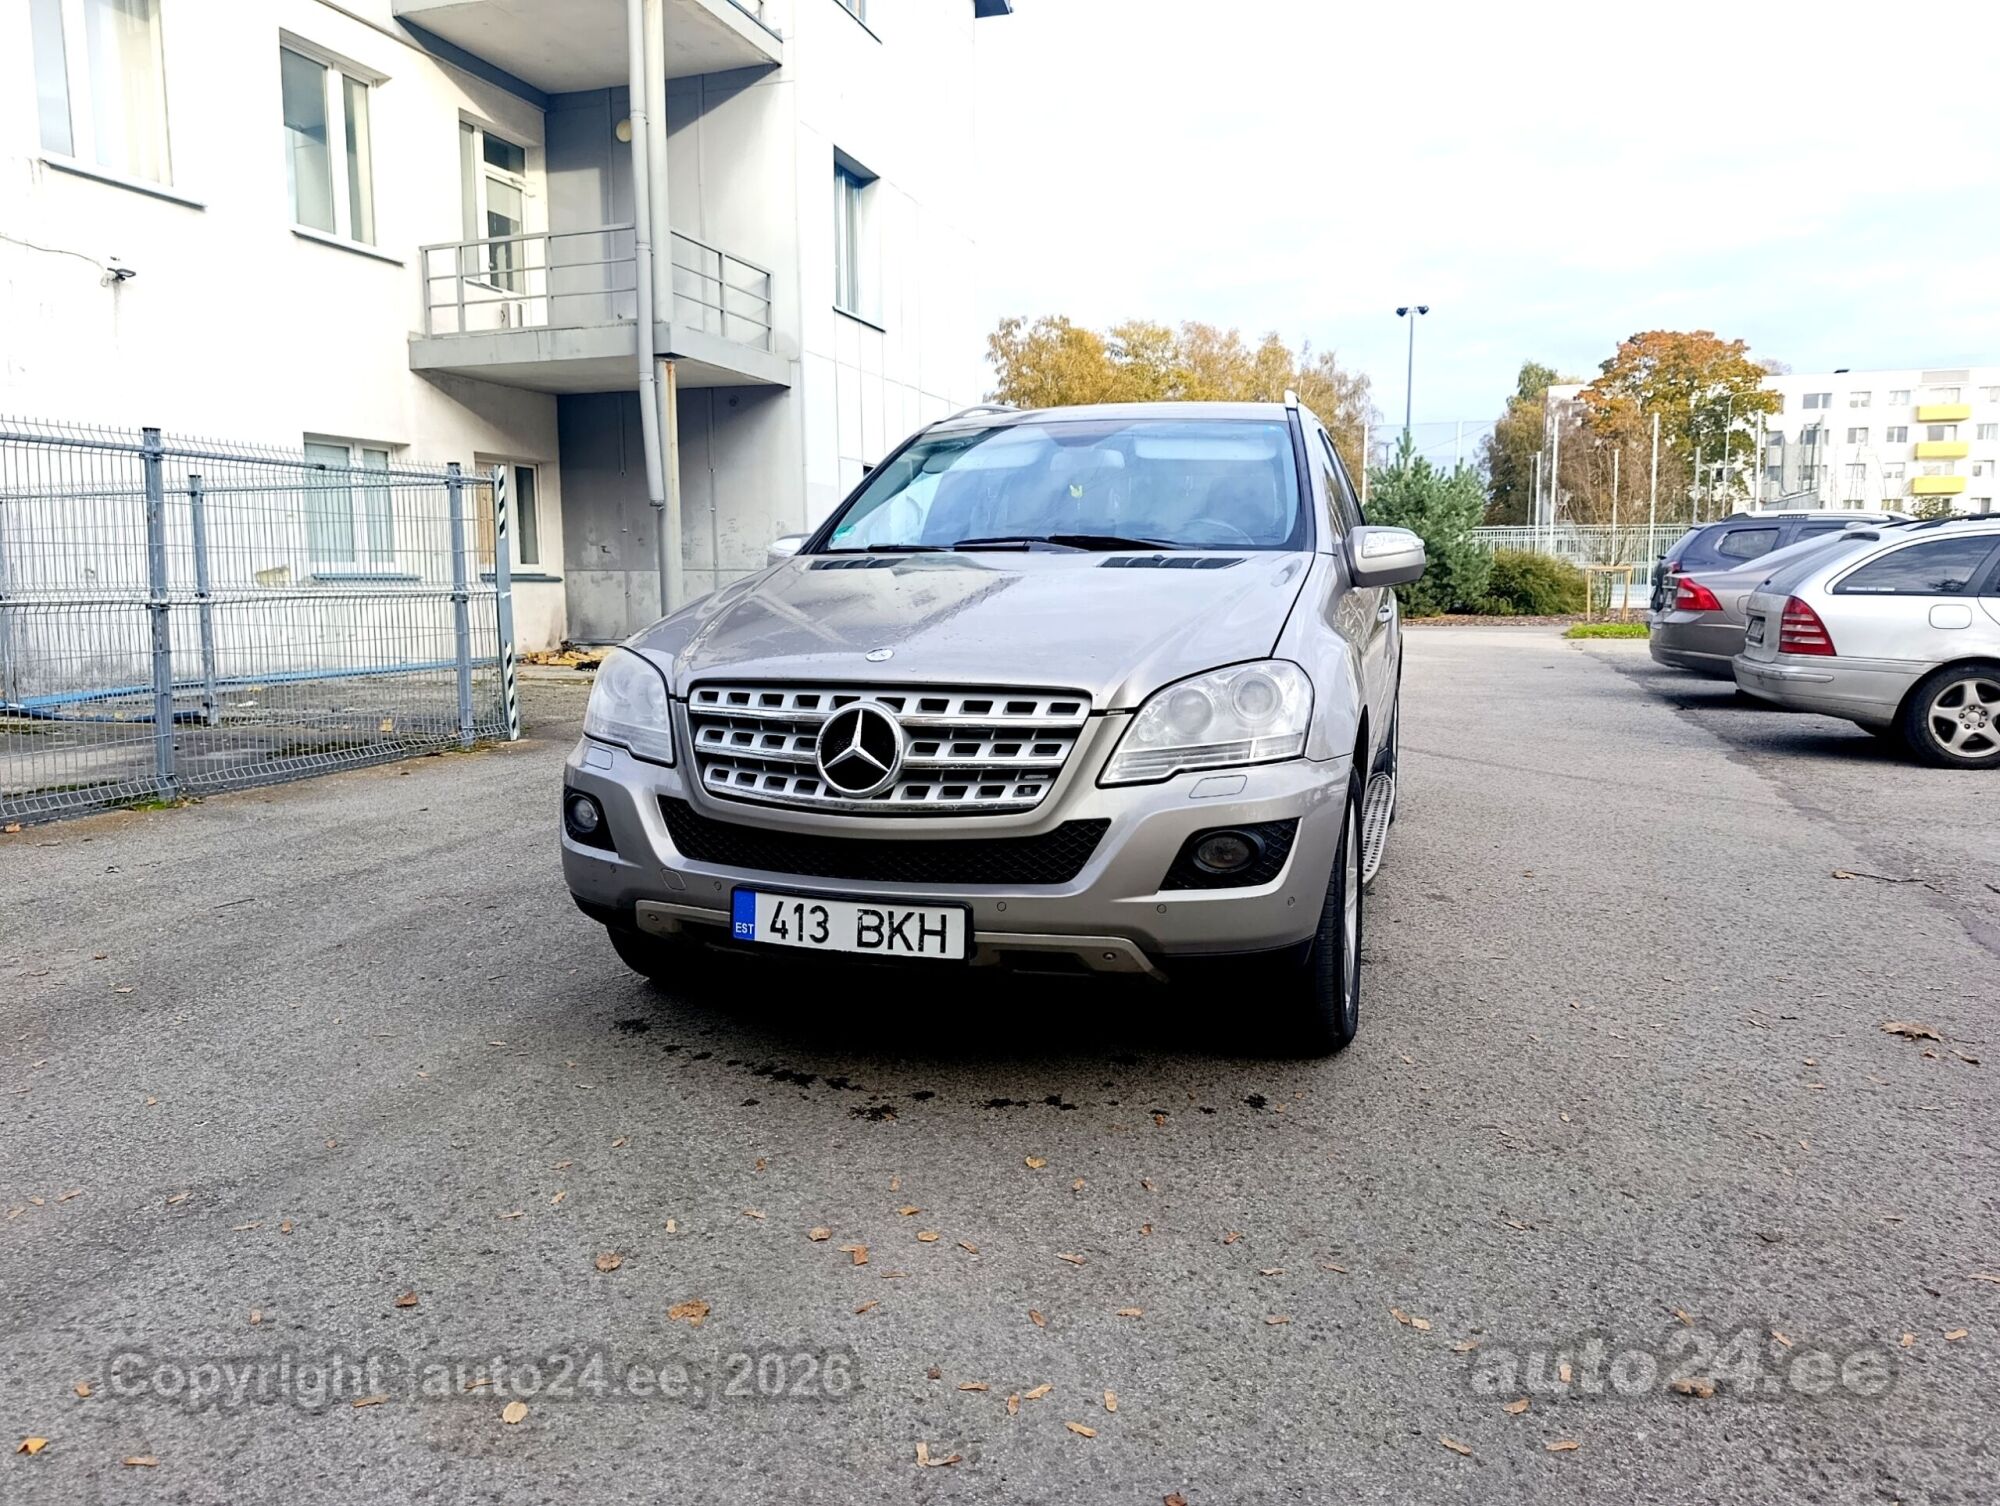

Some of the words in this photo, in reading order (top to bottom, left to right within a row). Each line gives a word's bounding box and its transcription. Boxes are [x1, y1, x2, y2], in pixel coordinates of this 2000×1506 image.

[735, 922, 755, 935] EST
[769, 901, 830, 944] 413
[856, 908, 948, 954] BKH
